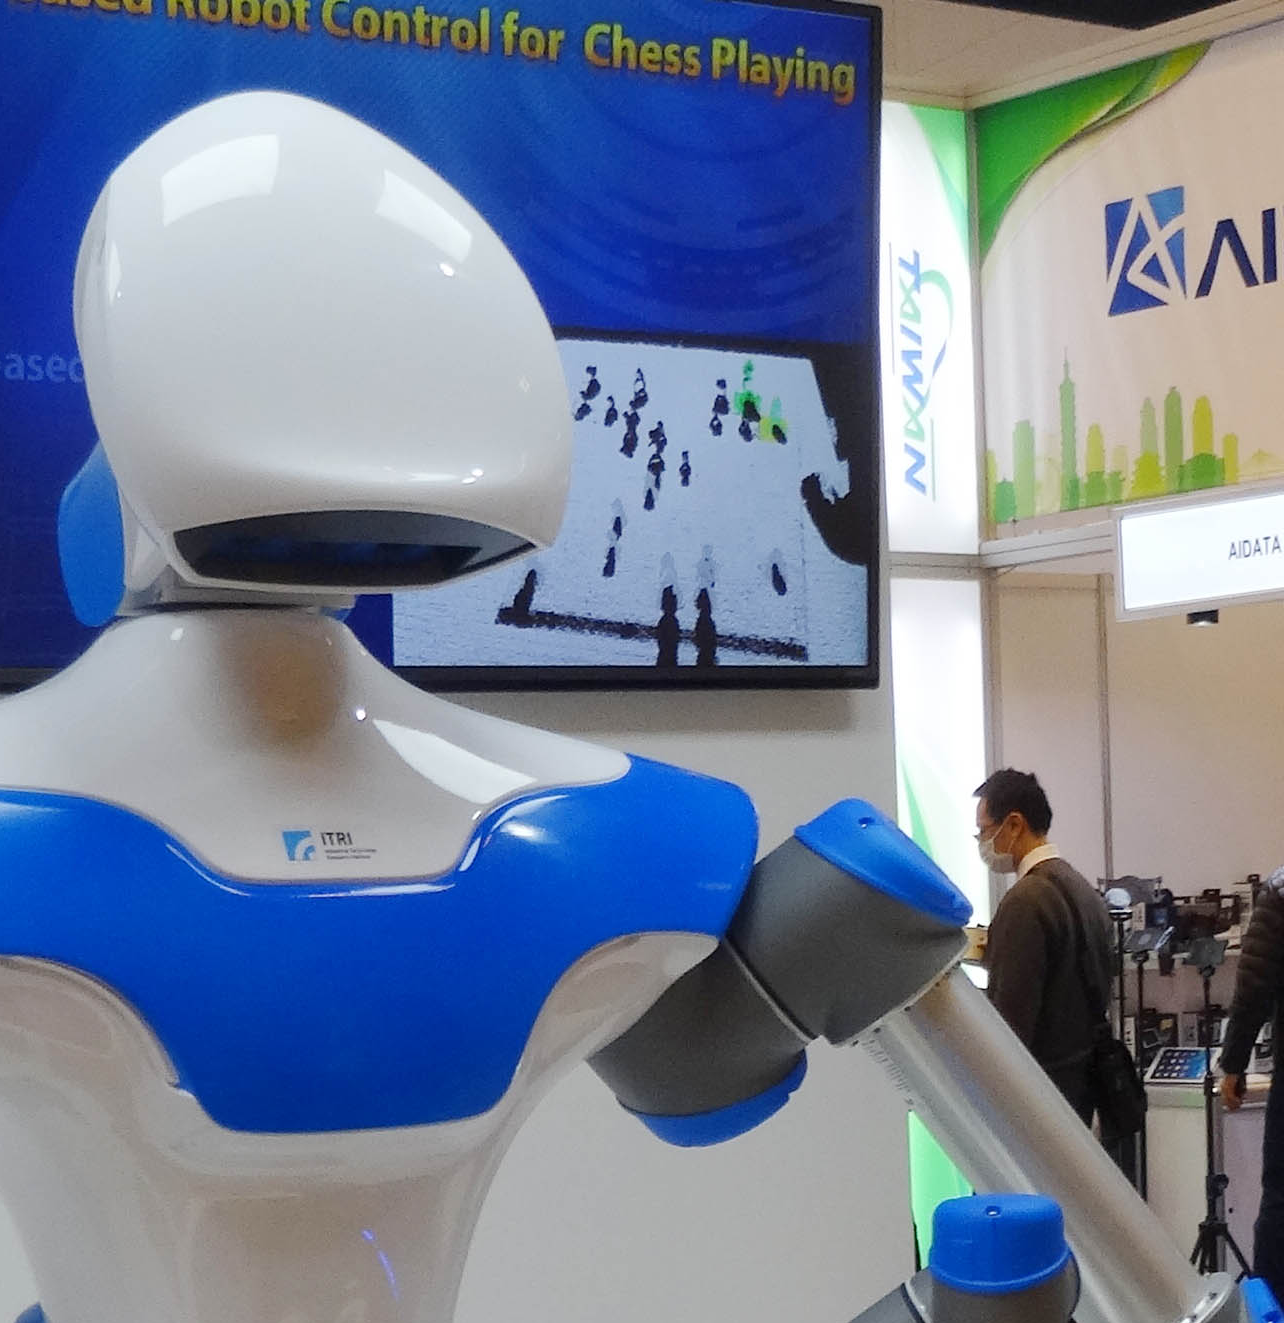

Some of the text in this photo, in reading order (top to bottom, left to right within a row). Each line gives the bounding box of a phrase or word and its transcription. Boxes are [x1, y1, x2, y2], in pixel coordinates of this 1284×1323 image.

[321, 0, 491, 54] Control
[501, 11, 565, 62] for
[583, 23, 702, 77] Chess
[711, 37, 856, 105] Playing
[898, 249, 927, 496] TAIWAN
[1228, 535, 1282, 561] AIDATA
[319, 831, 353, 846] ITRI
